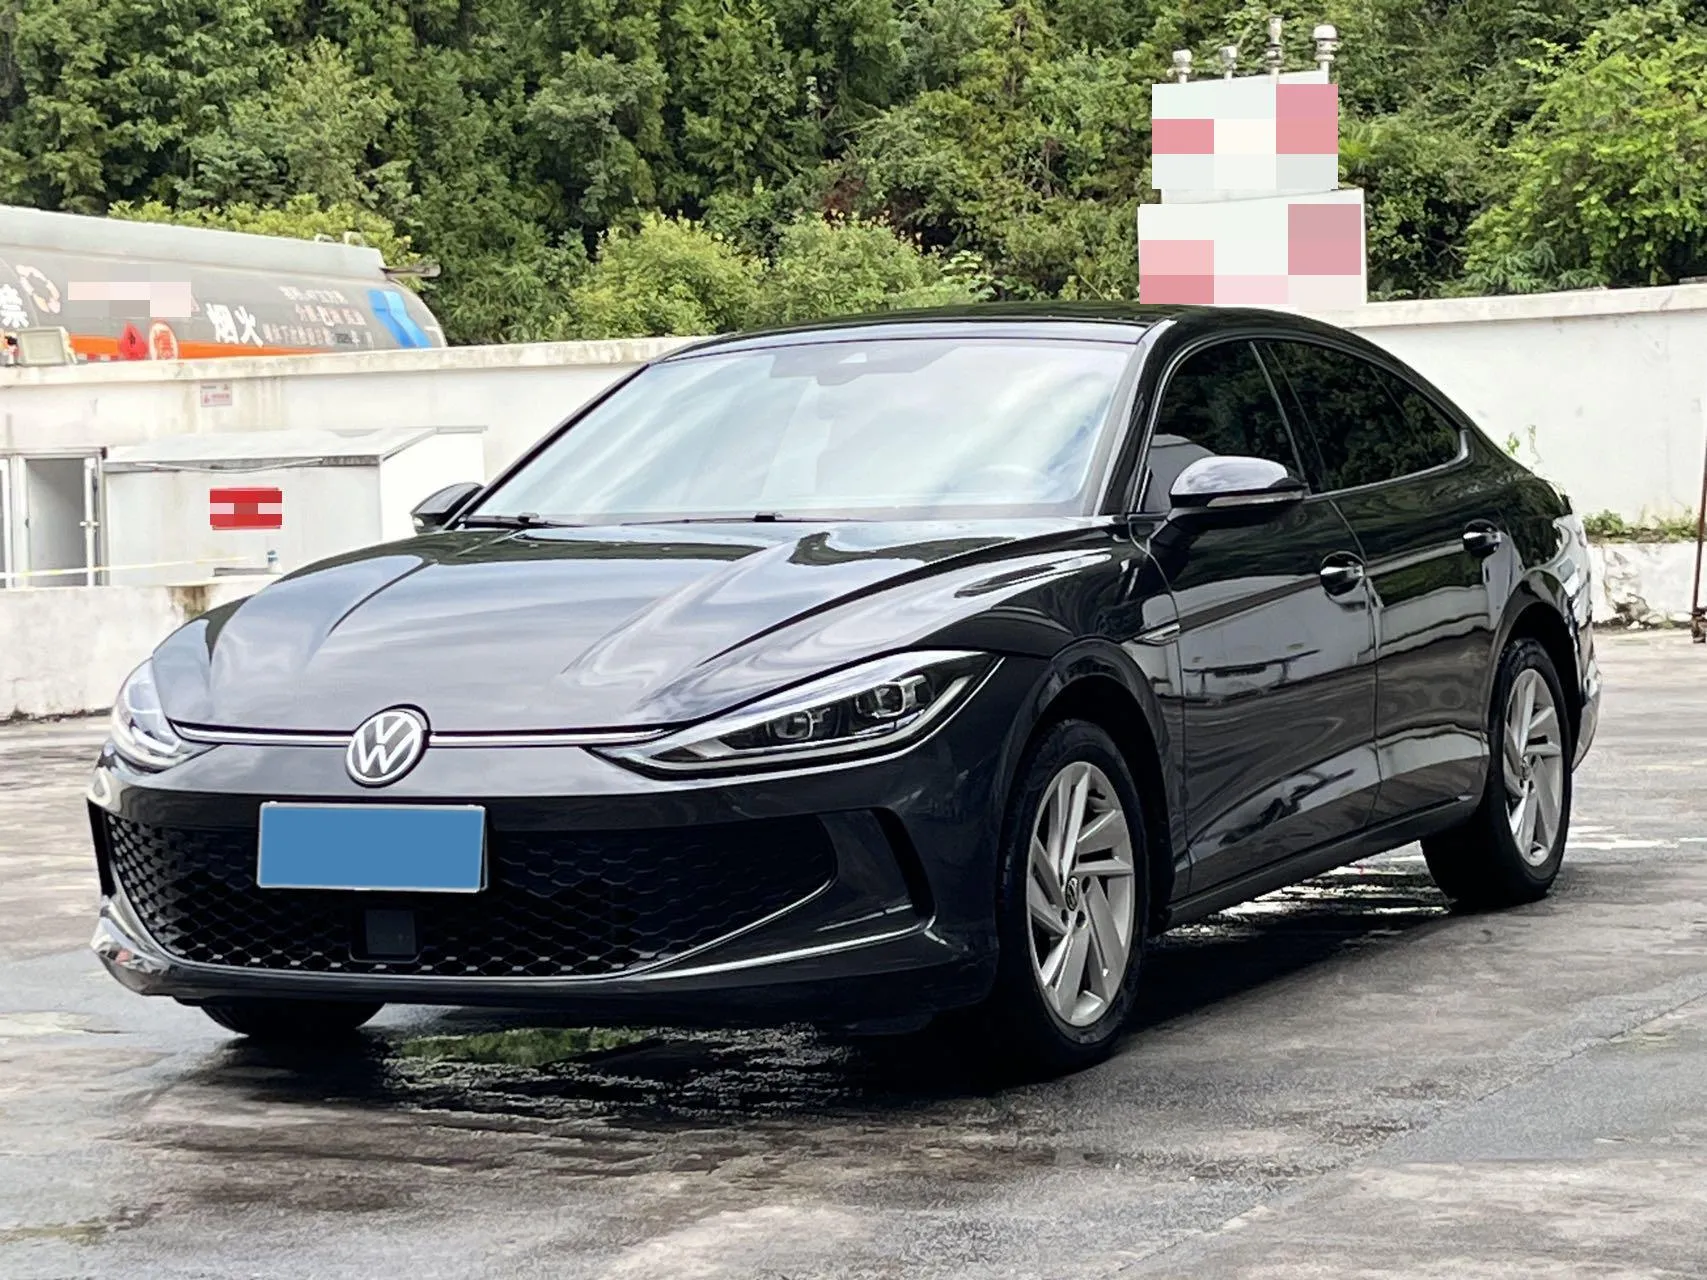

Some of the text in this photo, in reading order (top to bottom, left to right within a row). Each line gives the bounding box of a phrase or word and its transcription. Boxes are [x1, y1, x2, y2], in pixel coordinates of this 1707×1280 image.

[0, 284, 29, 328] 禁
[206, 303, 264, 347] 烟火
[353, 712, 418, 777] VW
